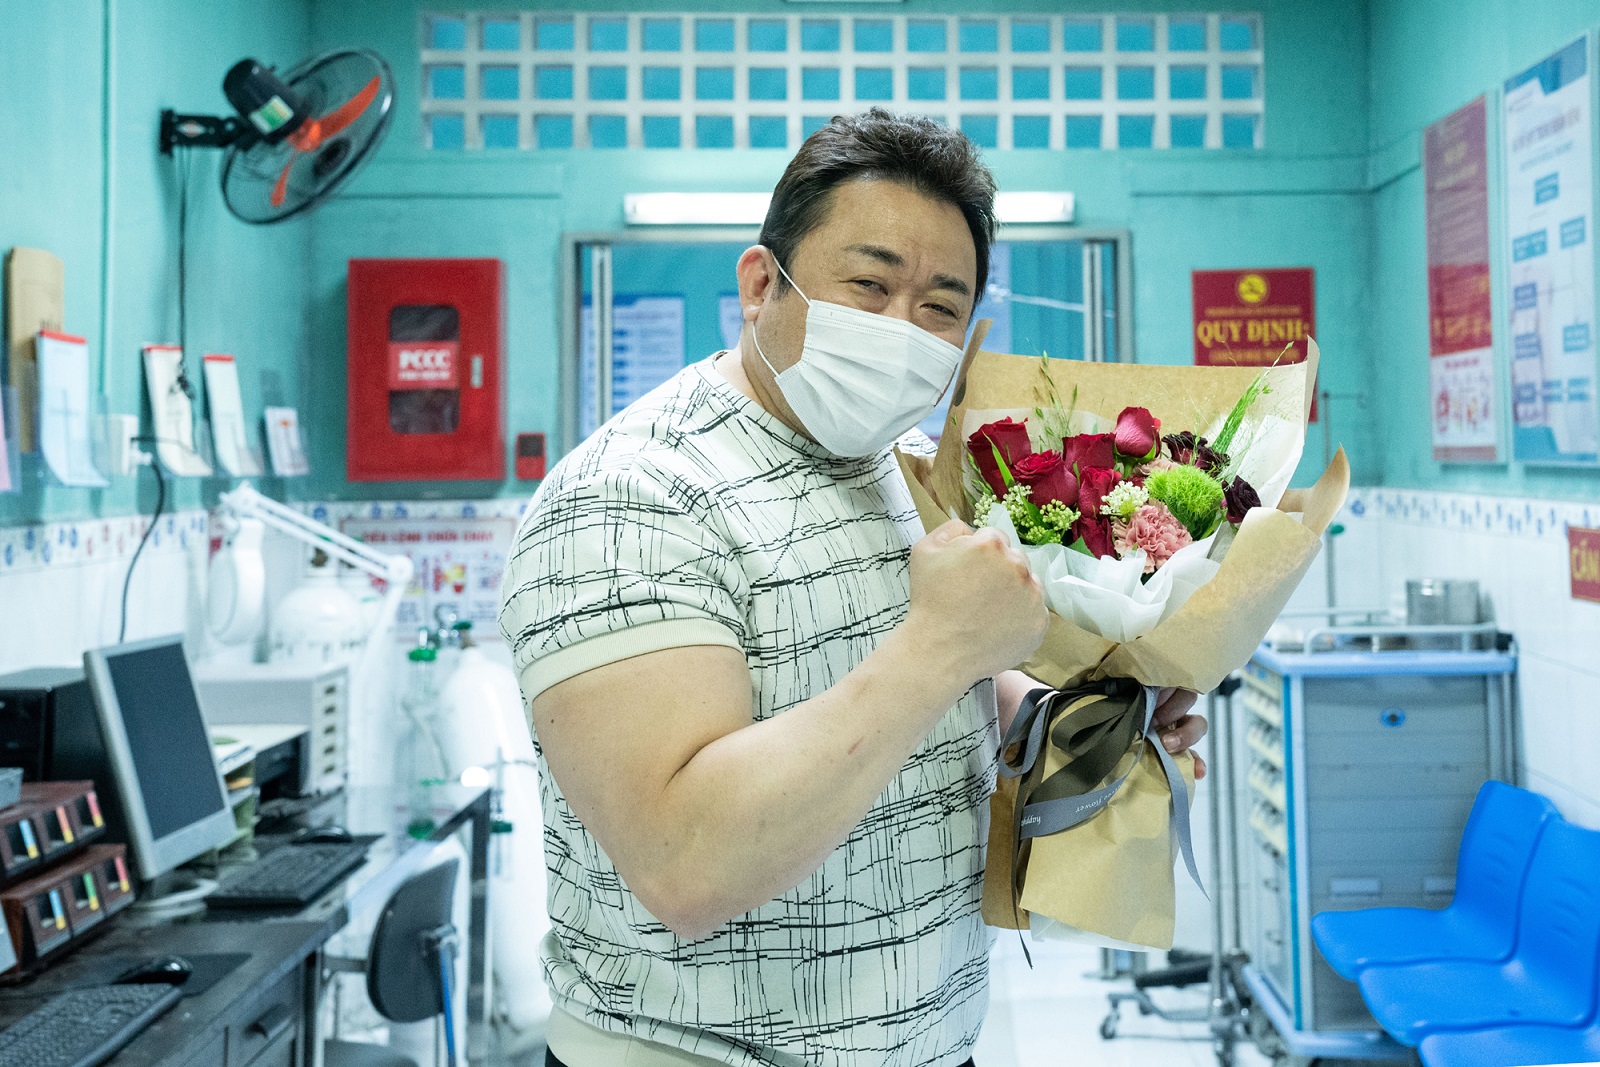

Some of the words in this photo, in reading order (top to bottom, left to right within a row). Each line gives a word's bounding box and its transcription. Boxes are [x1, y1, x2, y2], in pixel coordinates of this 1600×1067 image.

[1197, 319, 1242, 348] QUY
[400, 350, 450, 369] PCCC
[1075, 798, 1102, 813] flower
